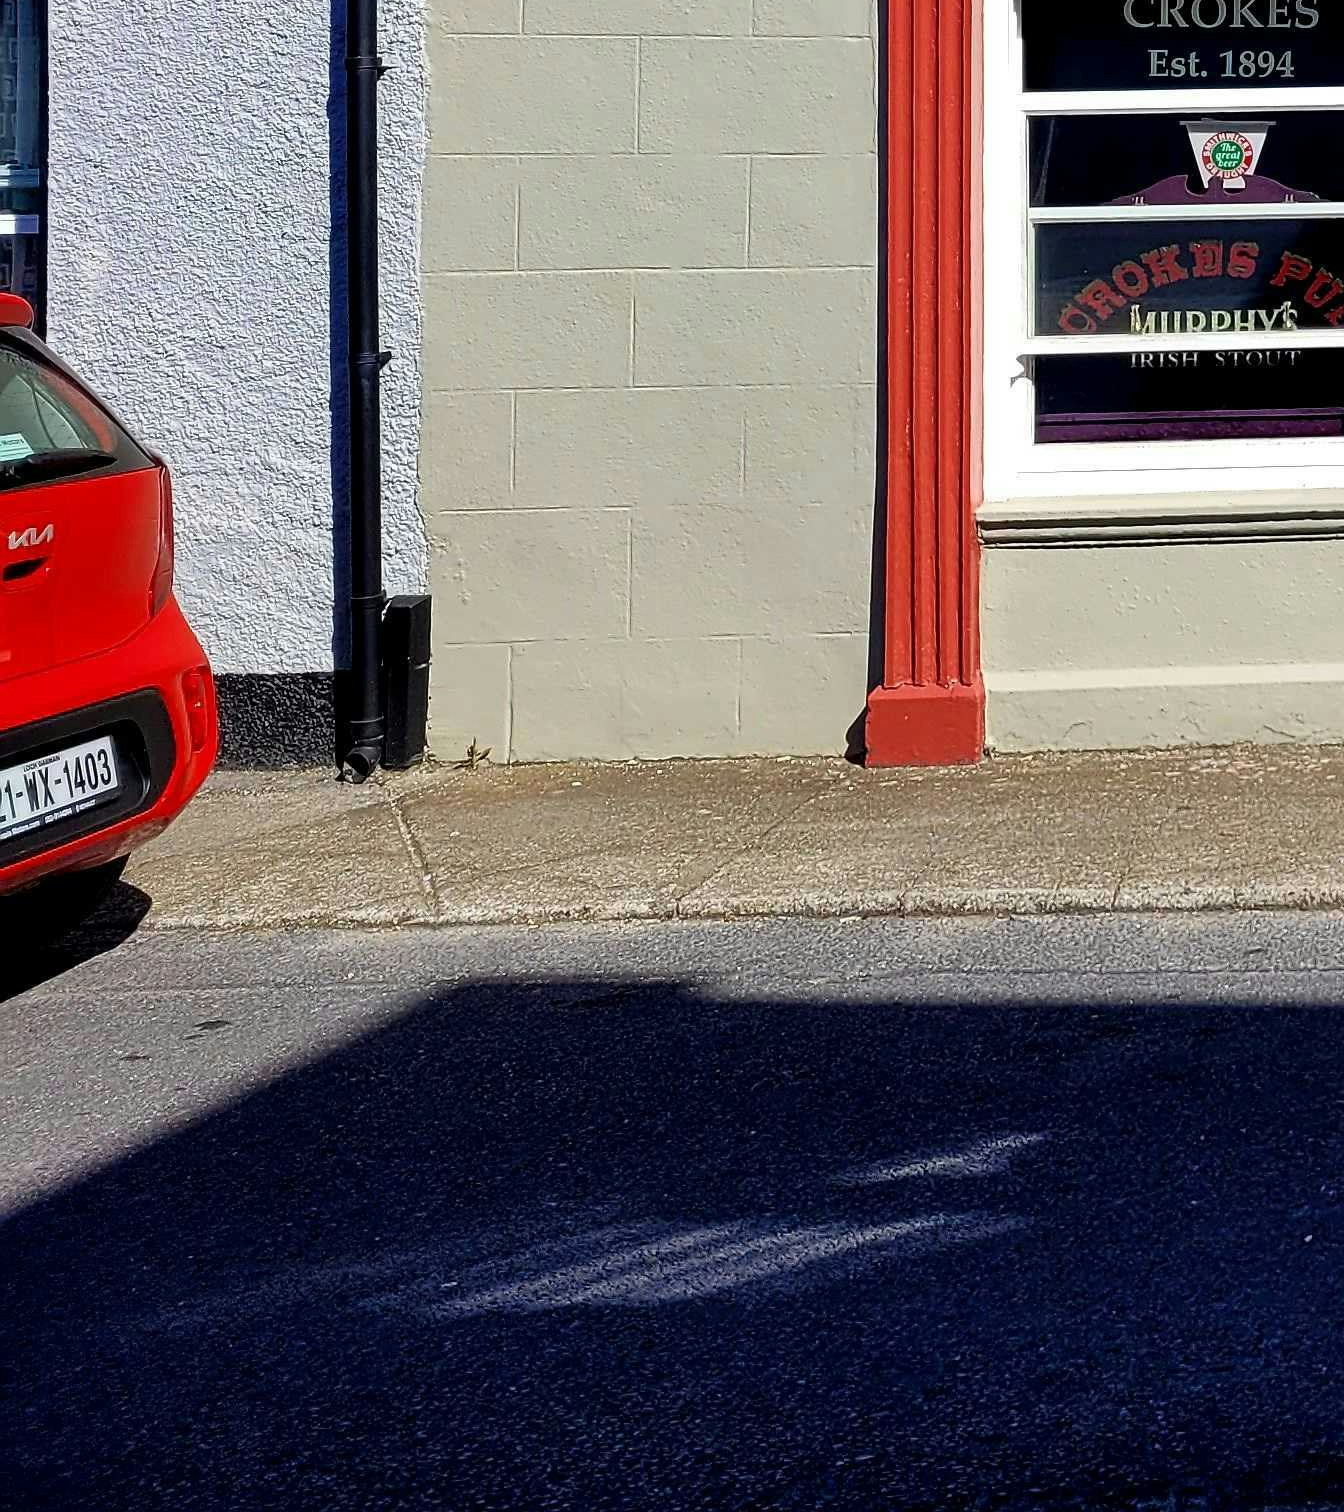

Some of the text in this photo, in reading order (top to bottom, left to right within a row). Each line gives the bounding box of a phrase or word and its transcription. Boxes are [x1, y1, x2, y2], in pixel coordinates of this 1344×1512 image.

[1147, 49, 1295, 78] Est. 1894
[1220, 142, 1237, 151] The
[1215, 151, 1240, 161] great
[1218, 160, 1239, 168] beer
[1131, 350, 1302, 368] IRISH STOUT
